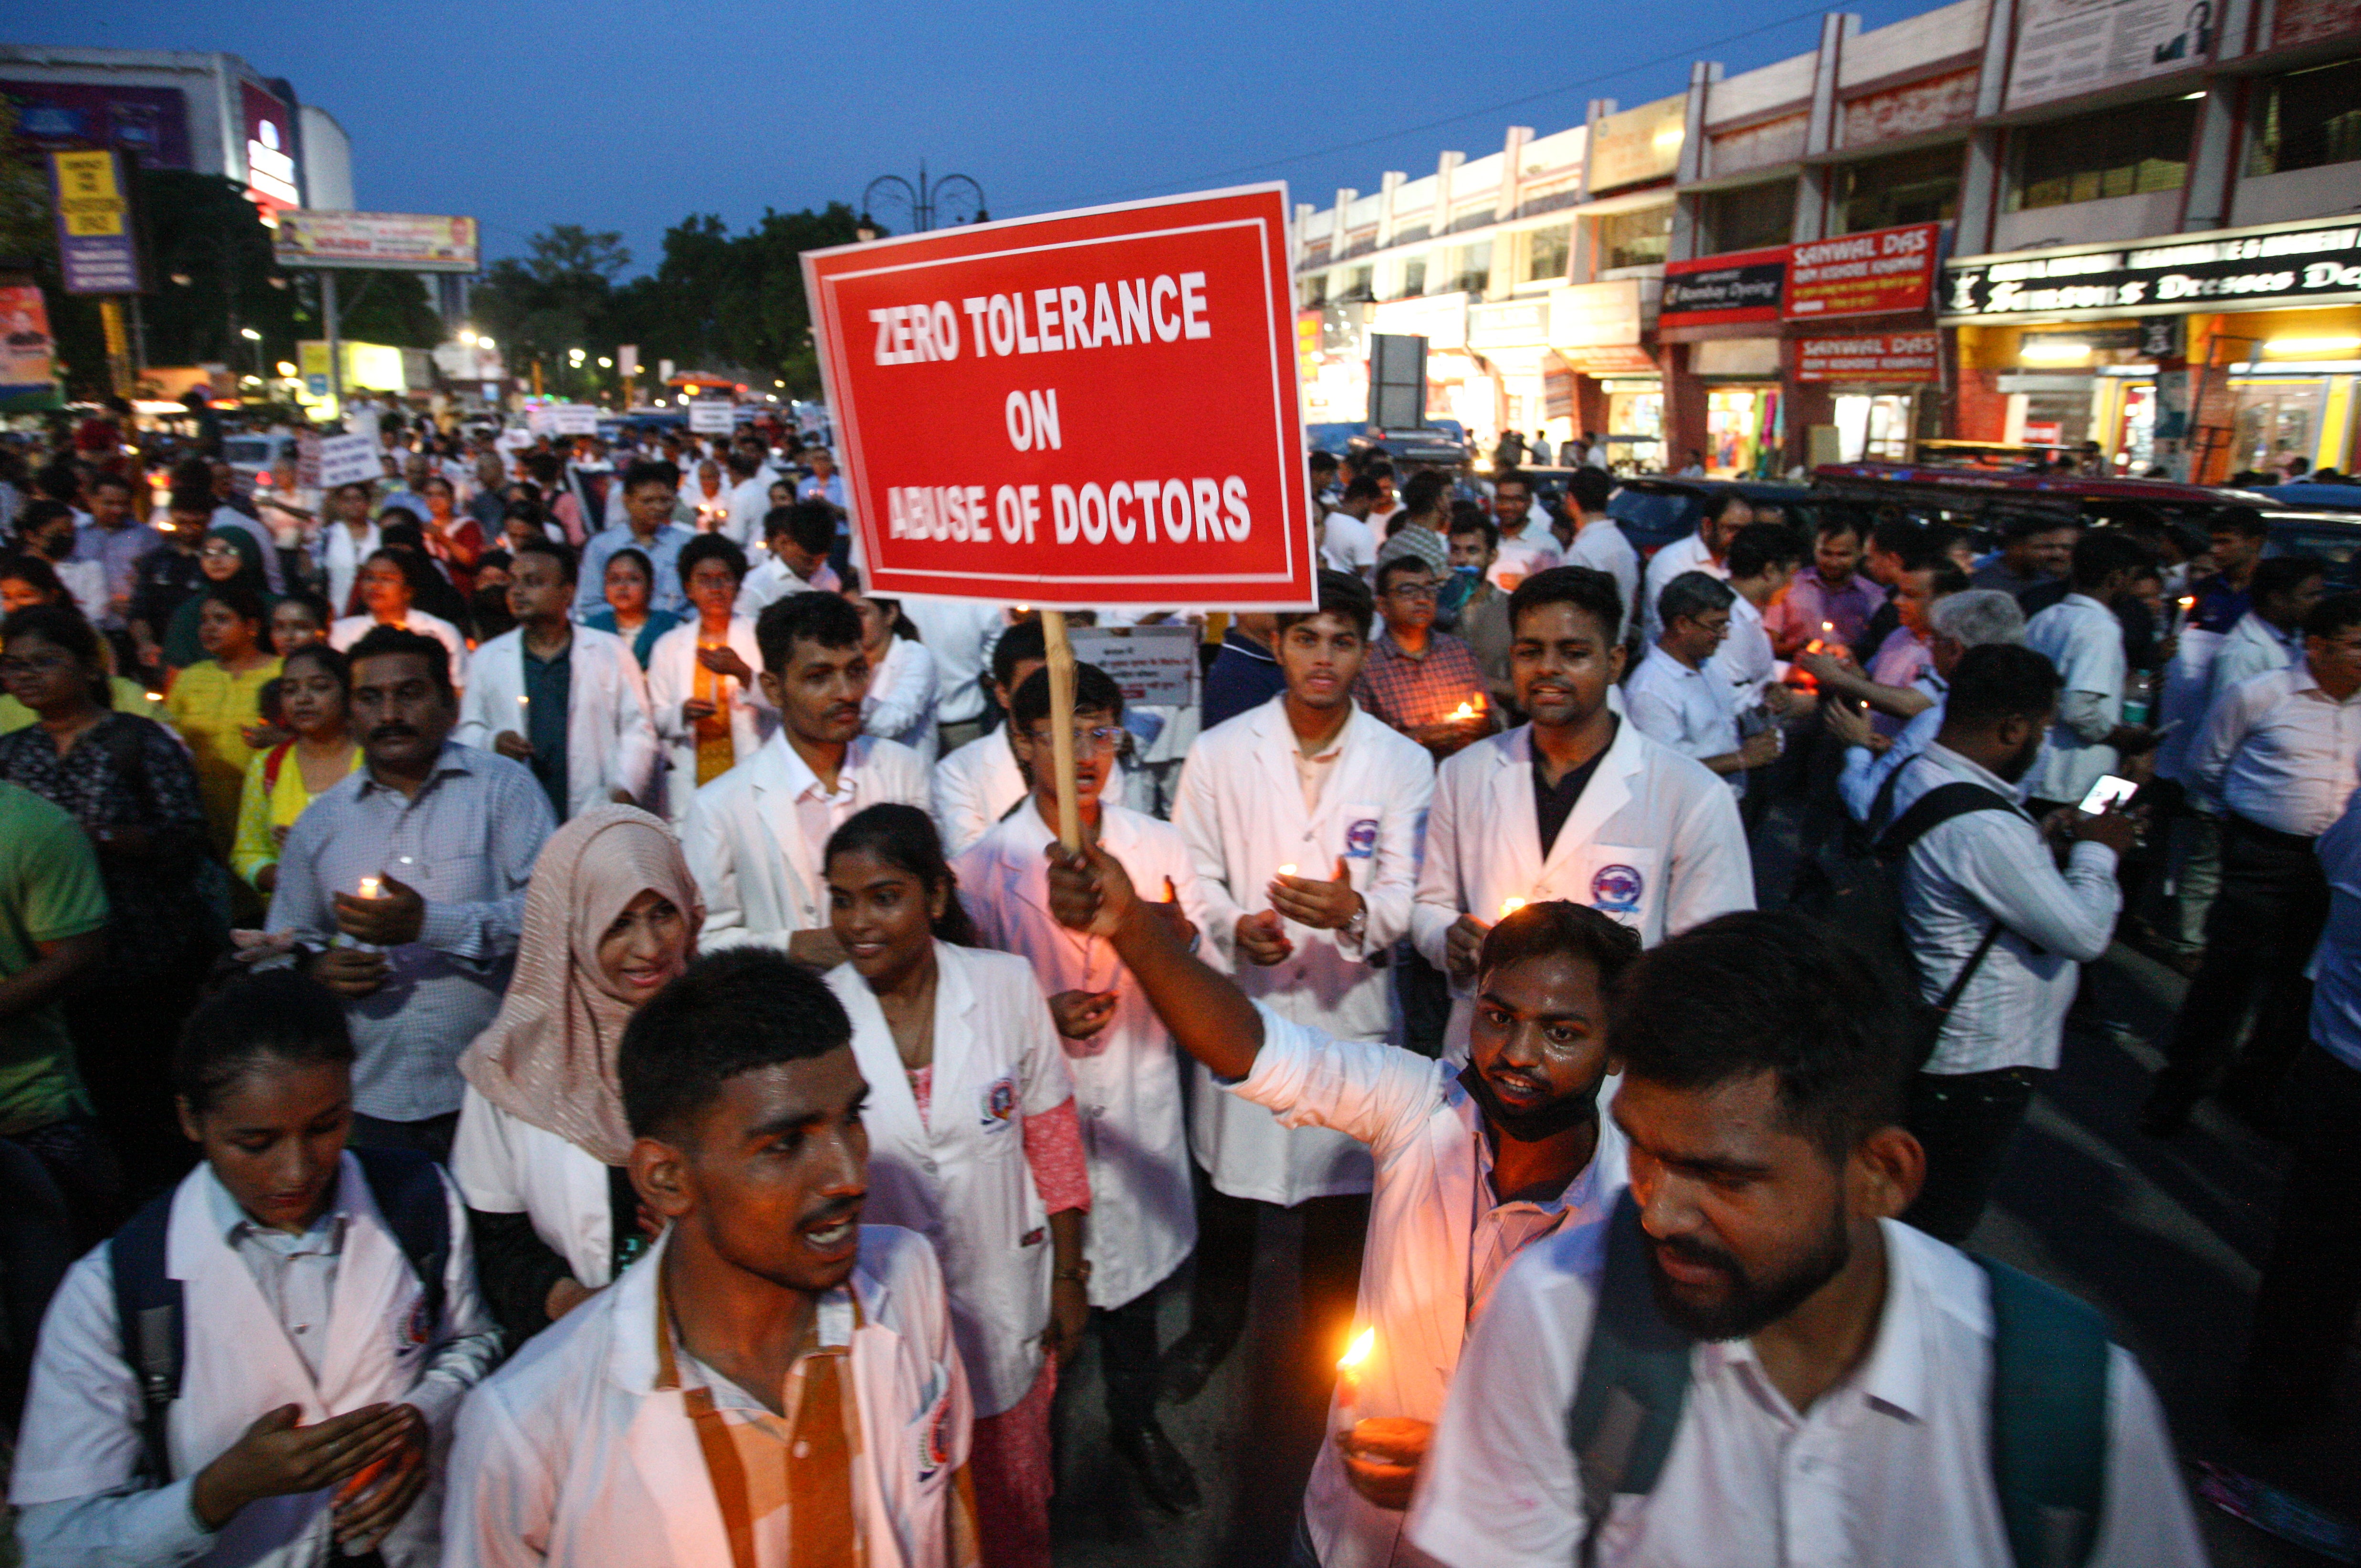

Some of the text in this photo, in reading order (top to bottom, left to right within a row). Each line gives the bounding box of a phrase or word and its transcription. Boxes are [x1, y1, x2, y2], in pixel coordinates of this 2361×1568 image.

[1794, 238, 1877, 266] SANWAL
[1882, 230, 1928, 254] DAS
[869, 271, 1211, 366] ZERO TOLERANCE
[1891, 337, 1935, 354] DAS
[1005, 388, 1062, 451] ON
[888, 475, 1252, 545] ABUSE OF DOCTORS
